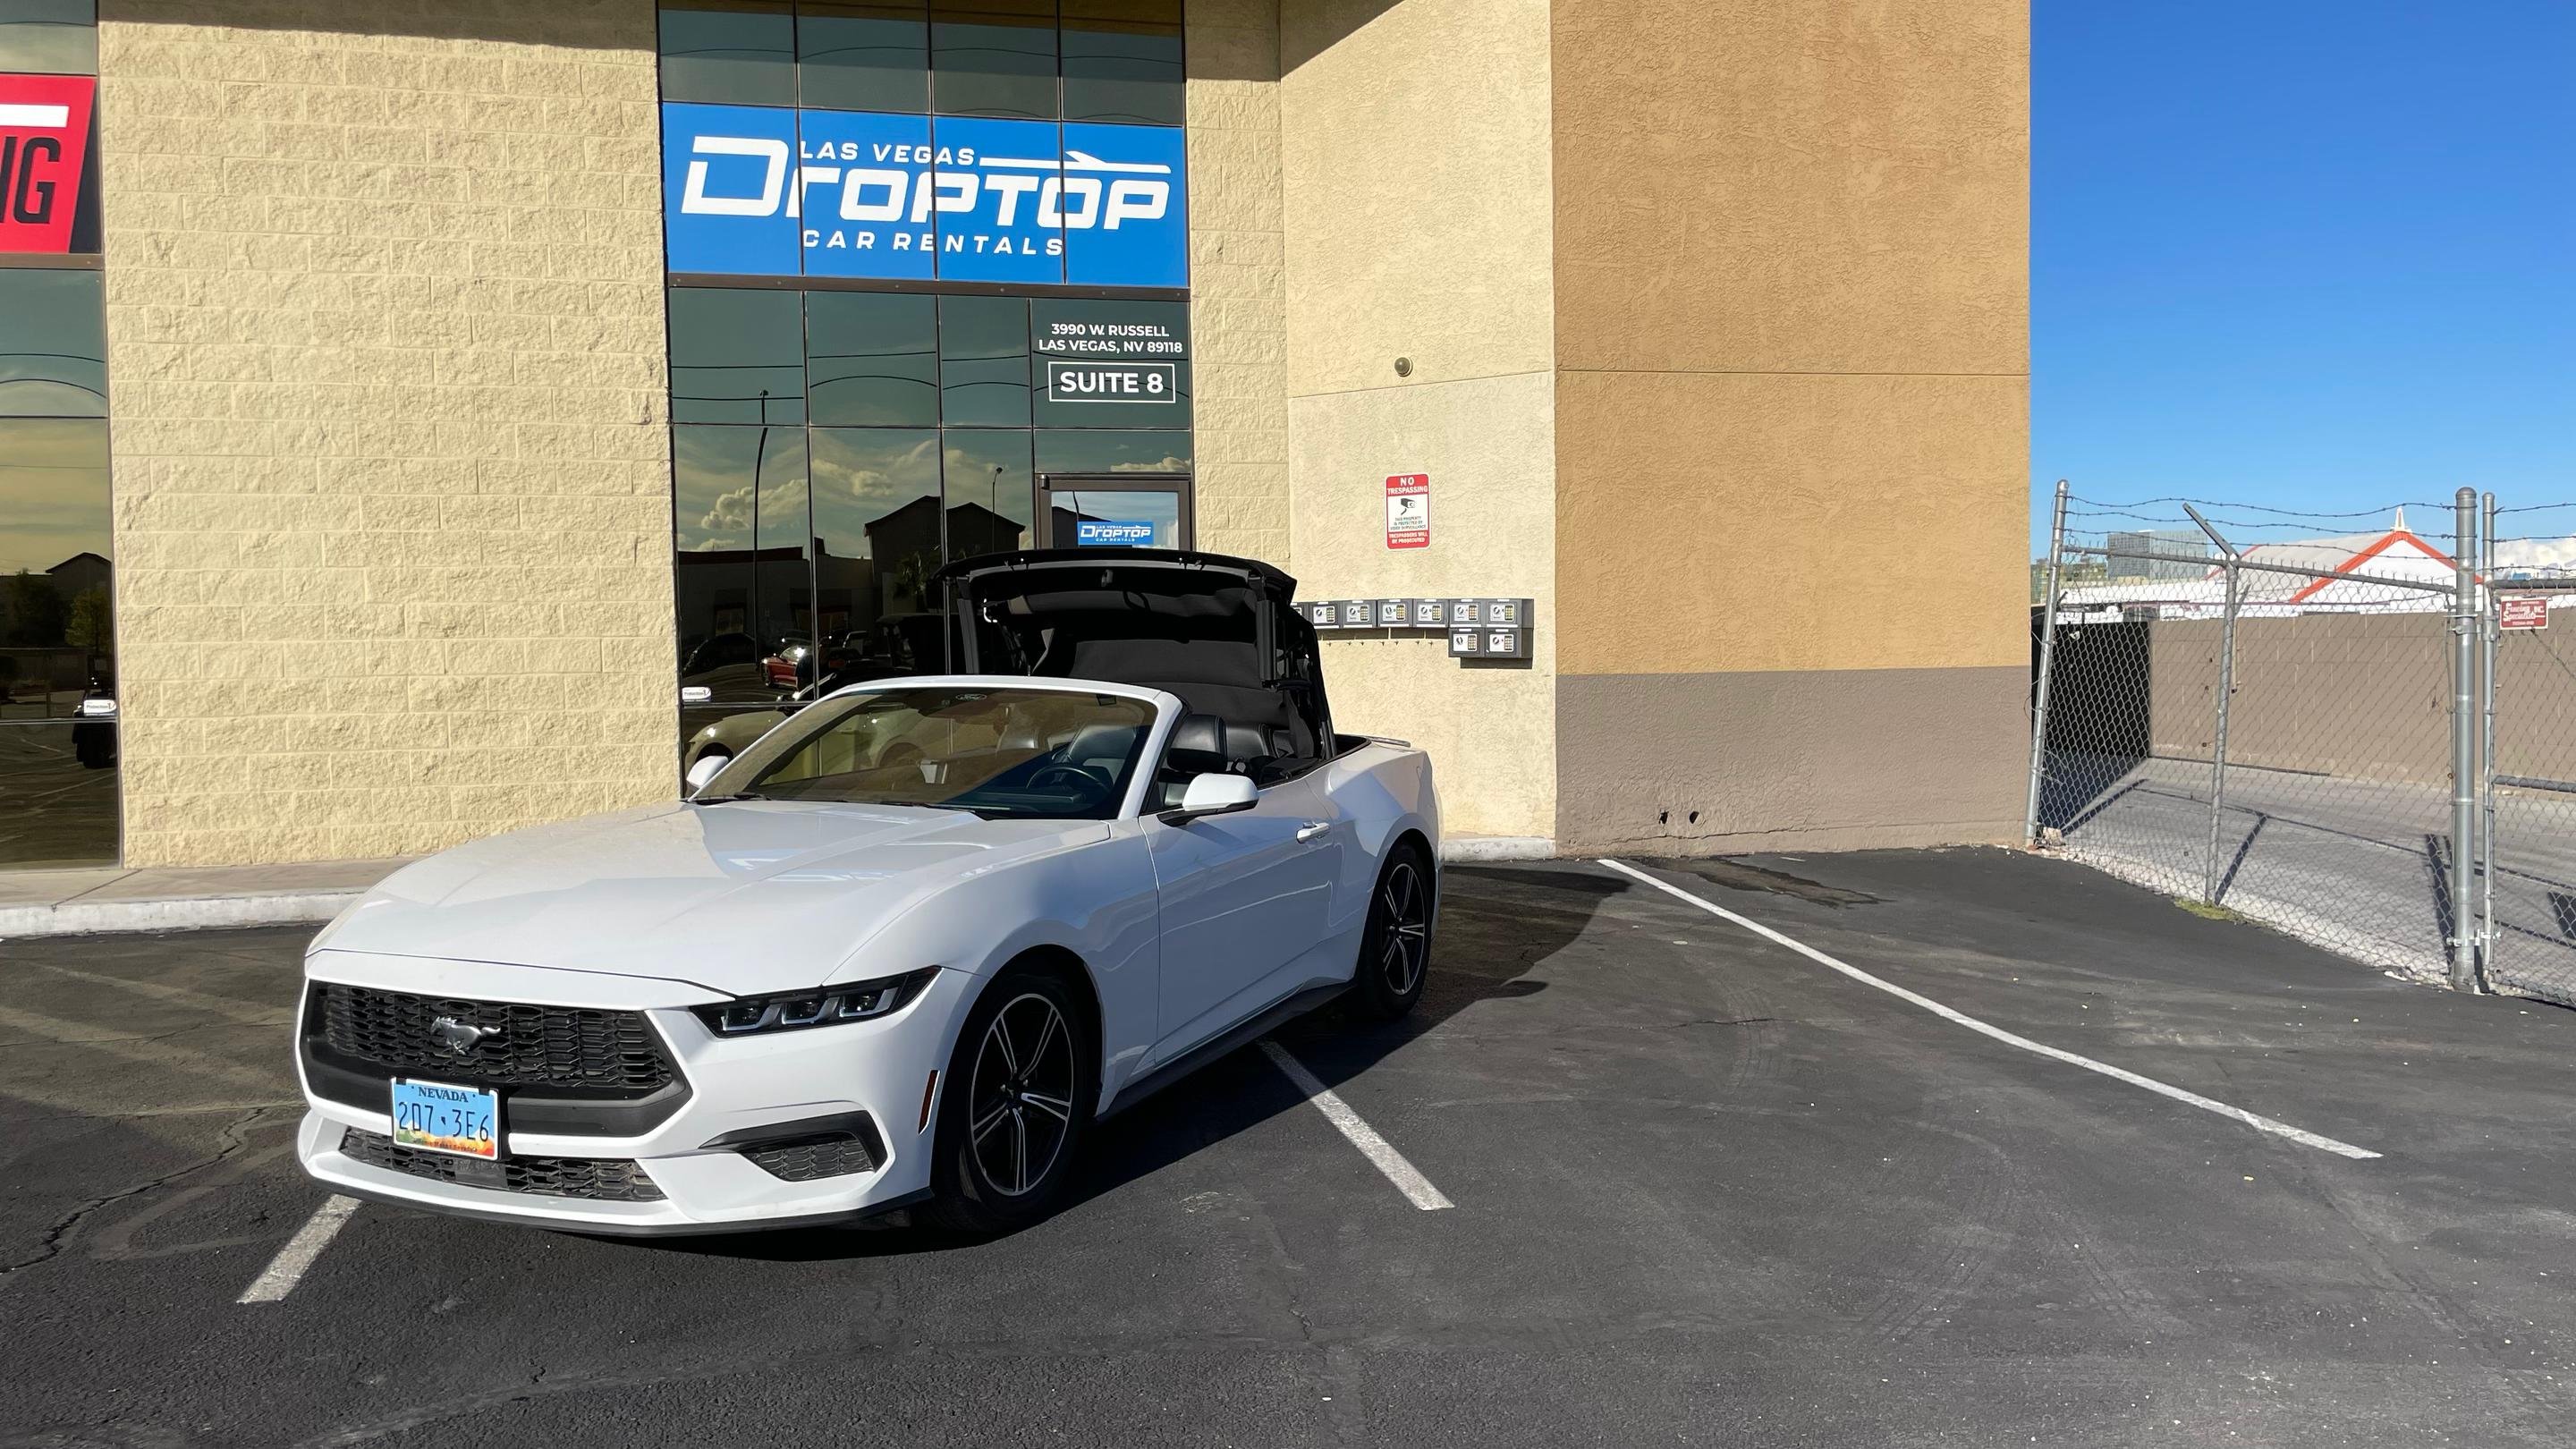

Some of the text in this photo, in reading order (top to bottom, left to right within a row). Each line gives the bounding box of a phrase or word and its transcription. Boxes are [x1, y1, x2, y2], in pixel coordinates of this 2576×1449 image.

[800, 140, 975, 166] LAS VEGAS
[802, 229, 1064, 256] CAR RENTALS
[1051, 323, 1086, 335] 3990
[1108, 325, 1169, 337] RUSSELL
[1038, 339, 1182, 354] LAS VEGAS, NV 89118
[1060, 371, 1164, 394] SUITE 8
[1400, 477, 1415, 487] NO
[1387, 486, 1428, 495] TRESPASSING
[419, 1086, 469, 1102] NEVADA
